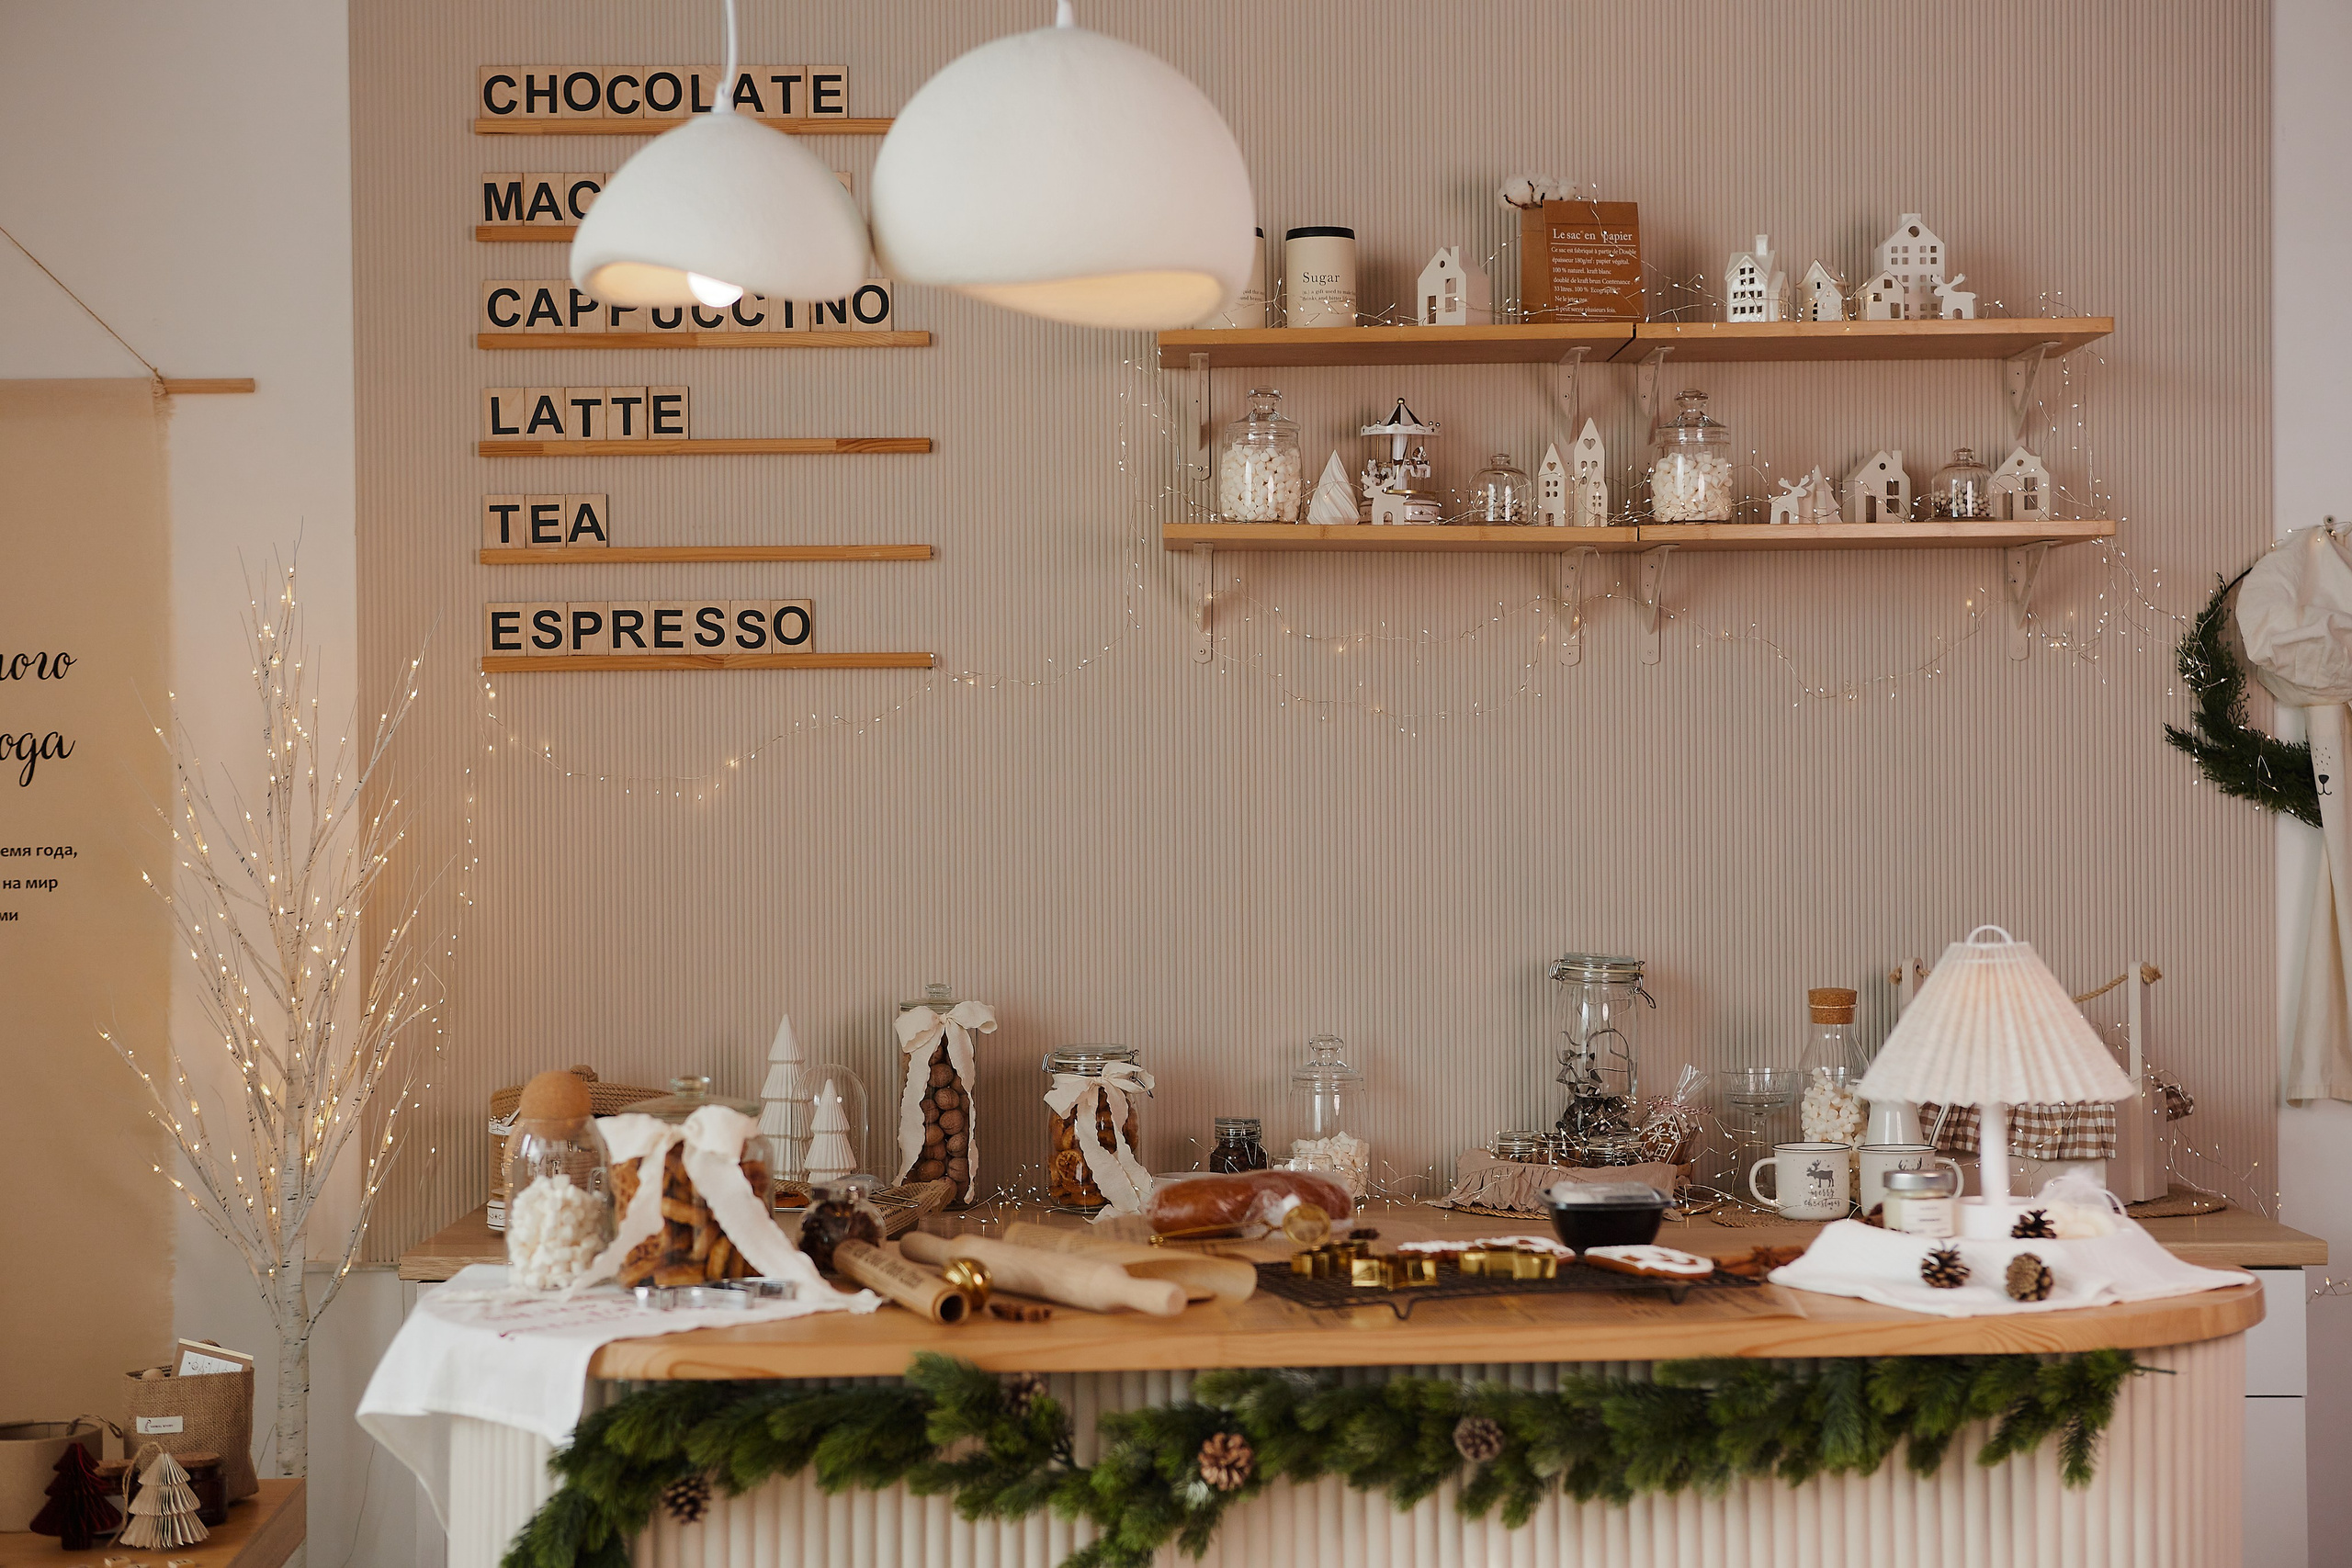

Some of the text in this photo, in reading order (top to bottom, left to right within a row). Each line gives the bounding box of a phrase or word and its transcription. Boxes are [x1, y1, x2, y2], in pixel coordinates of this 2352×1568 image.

[482, 72, 843, 114] CHOCOLATE
[1553, 229, 1566, 239] Le
[1603, 231, 1633, 243] papier
[1302, 271, 1340, 286] Sugar
[490, 395, 684, 437] LATTE
[489, 503, 606, 544] TEA
[490, 605, 810, 650] ESPRESSO
[0, 731, 75, 788] ода
[0, 845, 78, 860] емя года,
[3, 878, 58, 893] на мир
[0, 911, 18, 921] ми
[882, 1207, 902, 1221] rfection
